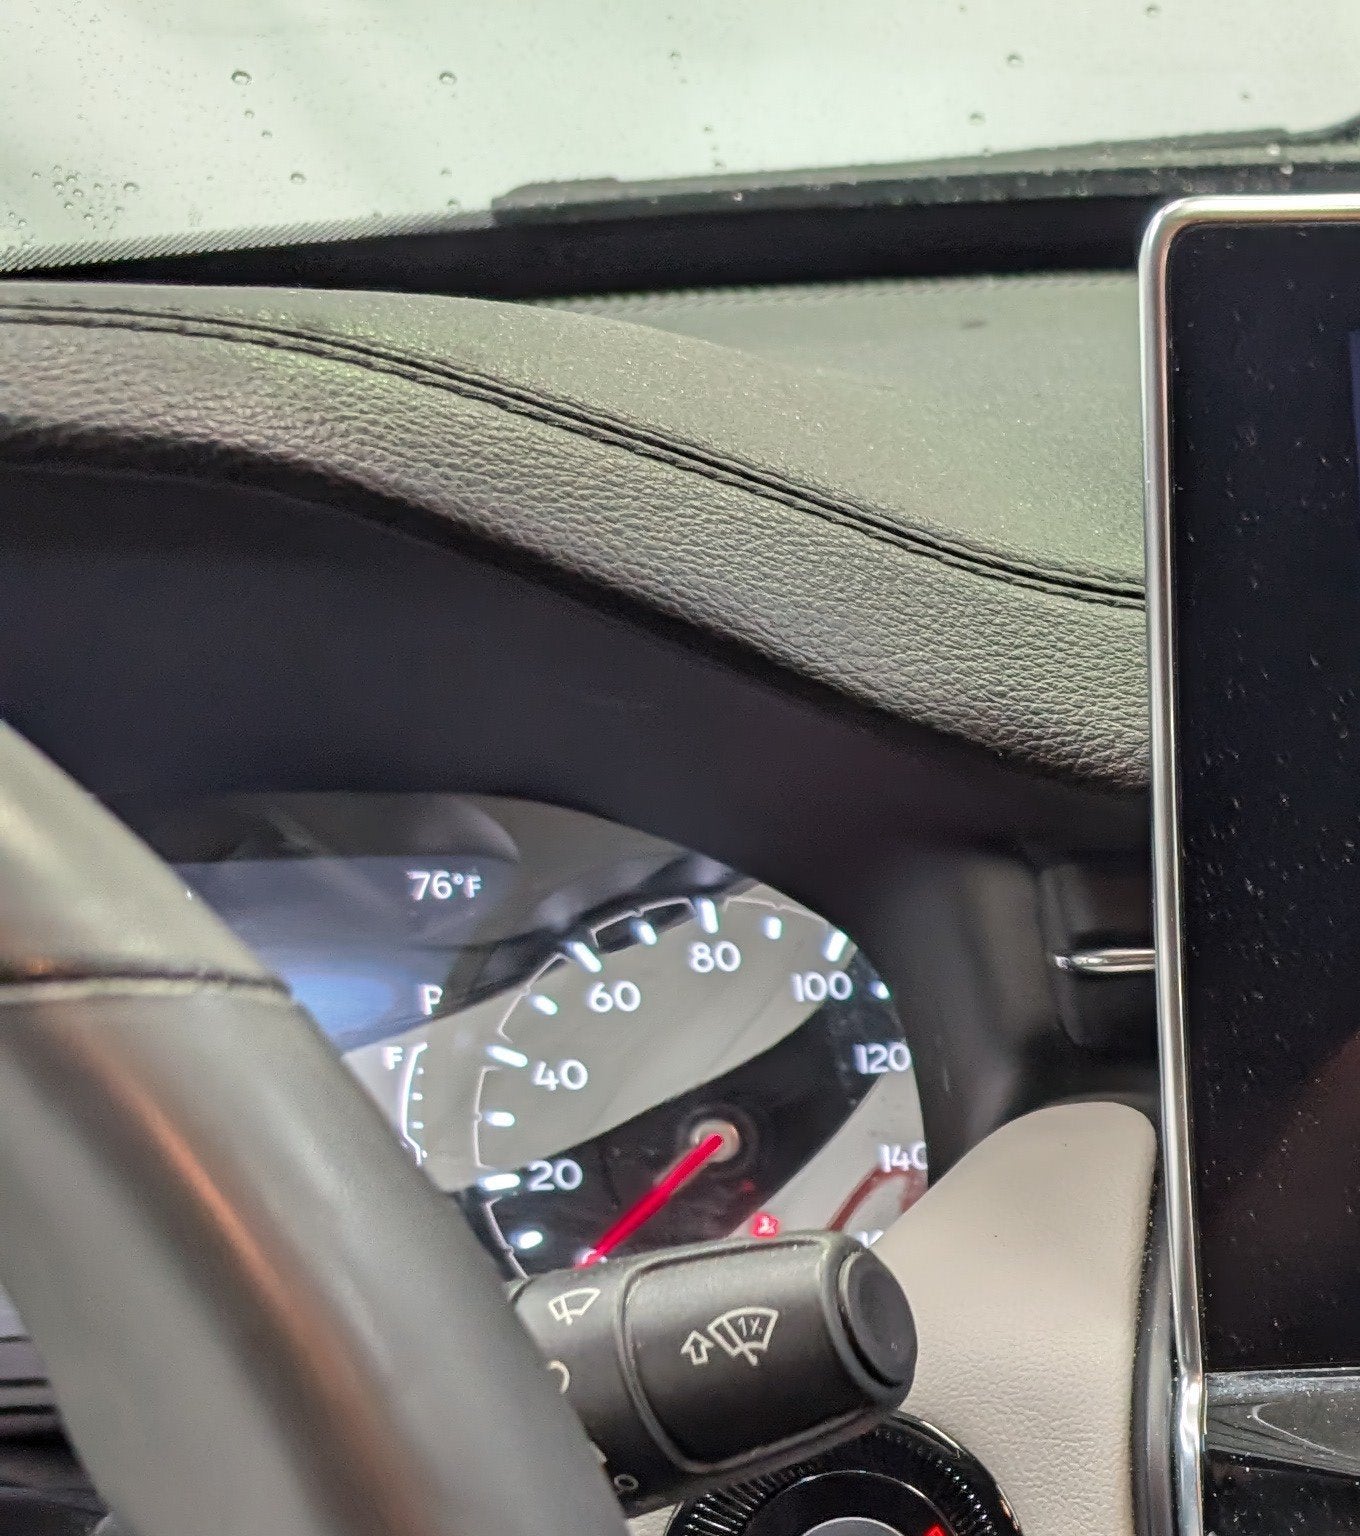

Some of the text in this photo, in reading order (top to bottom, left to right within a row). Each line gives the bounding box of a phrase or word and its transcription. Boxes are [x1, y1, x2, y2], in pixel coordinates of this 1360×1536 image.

[407, 871, 481, 900] 76°F
[689, 941, 740, 972] 80
[587, 981, 640, 1012] 60
[791, 971, 852, 1002] 100
[854, 1043, 912, 1074] 120
[534, 1060, 587, 1090] 40
[527, 1160, 583, 1191] 20
